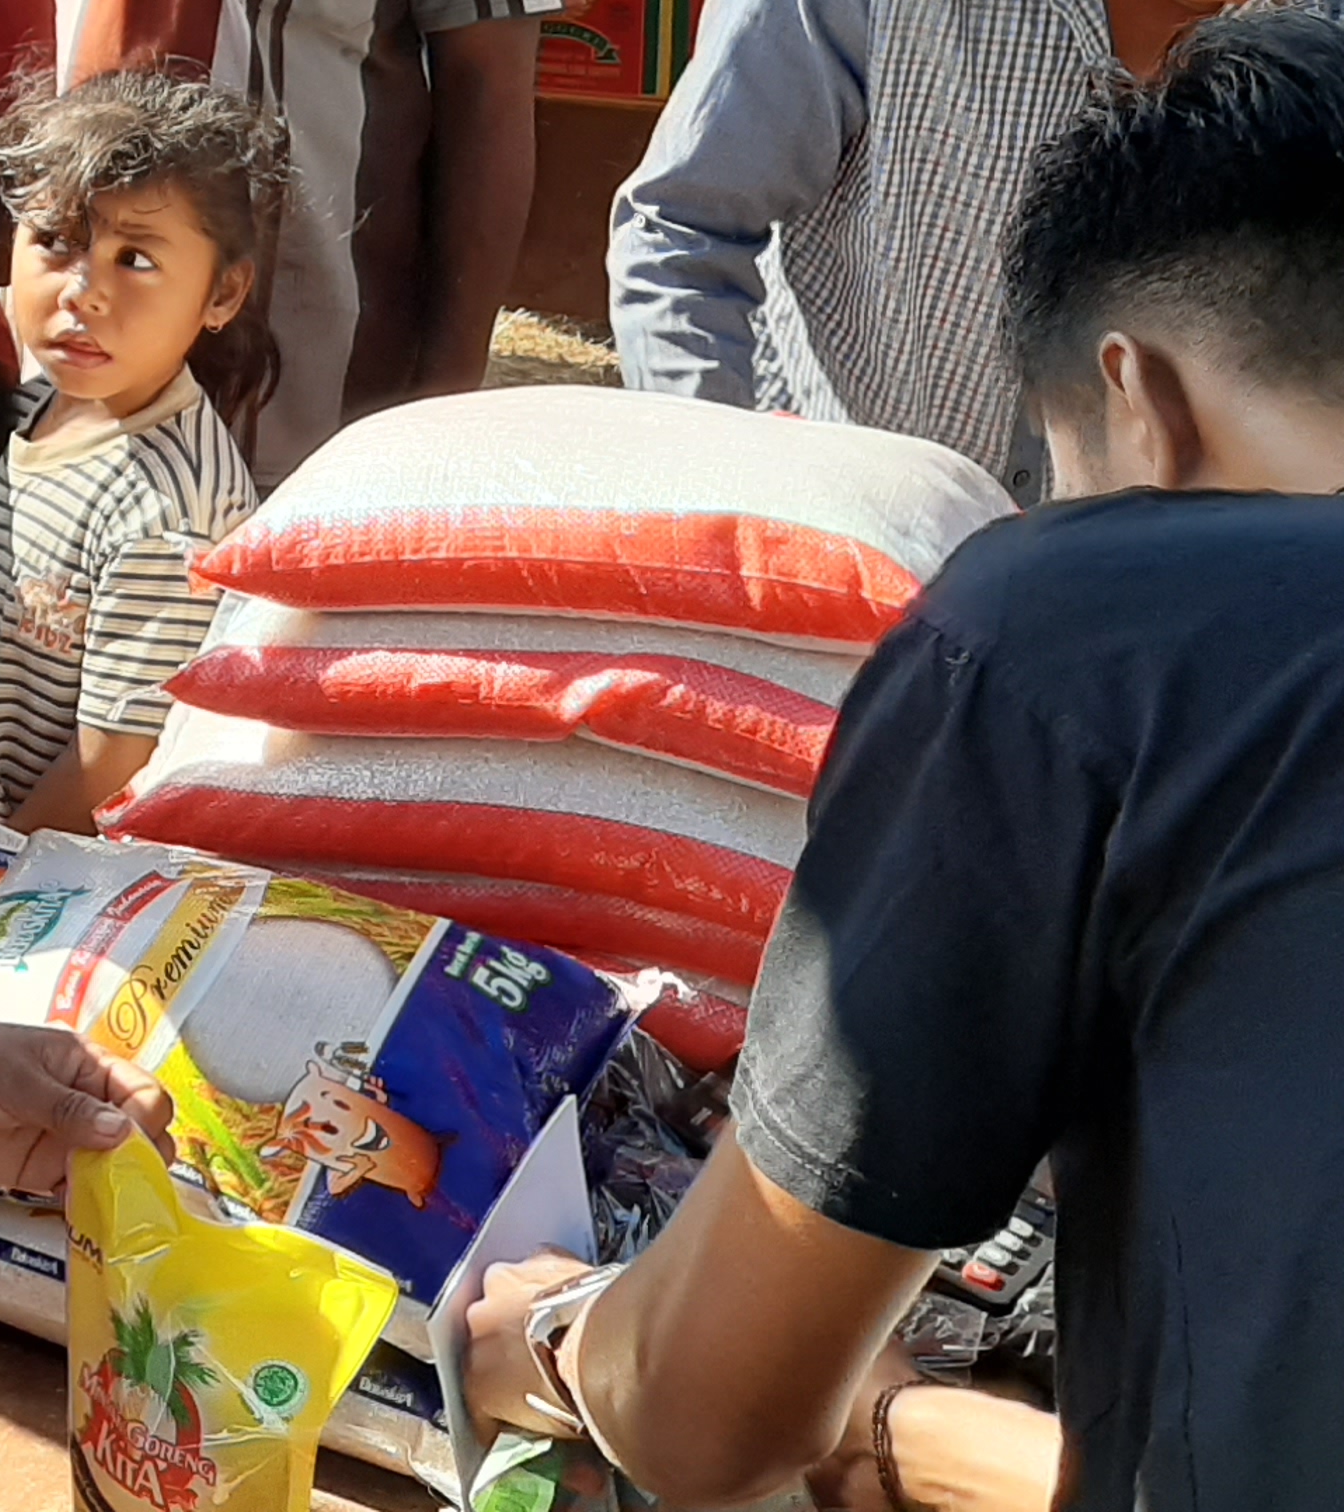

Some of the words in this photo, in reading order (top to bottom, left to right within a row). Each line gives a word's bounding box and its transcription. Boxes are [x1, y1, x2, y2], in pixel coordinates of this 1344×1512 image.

[109, 888, 238, 1053] Premium
[470, 945, 547, 1012] 5kg
[126, 1421, 217, 1486] GORENG
